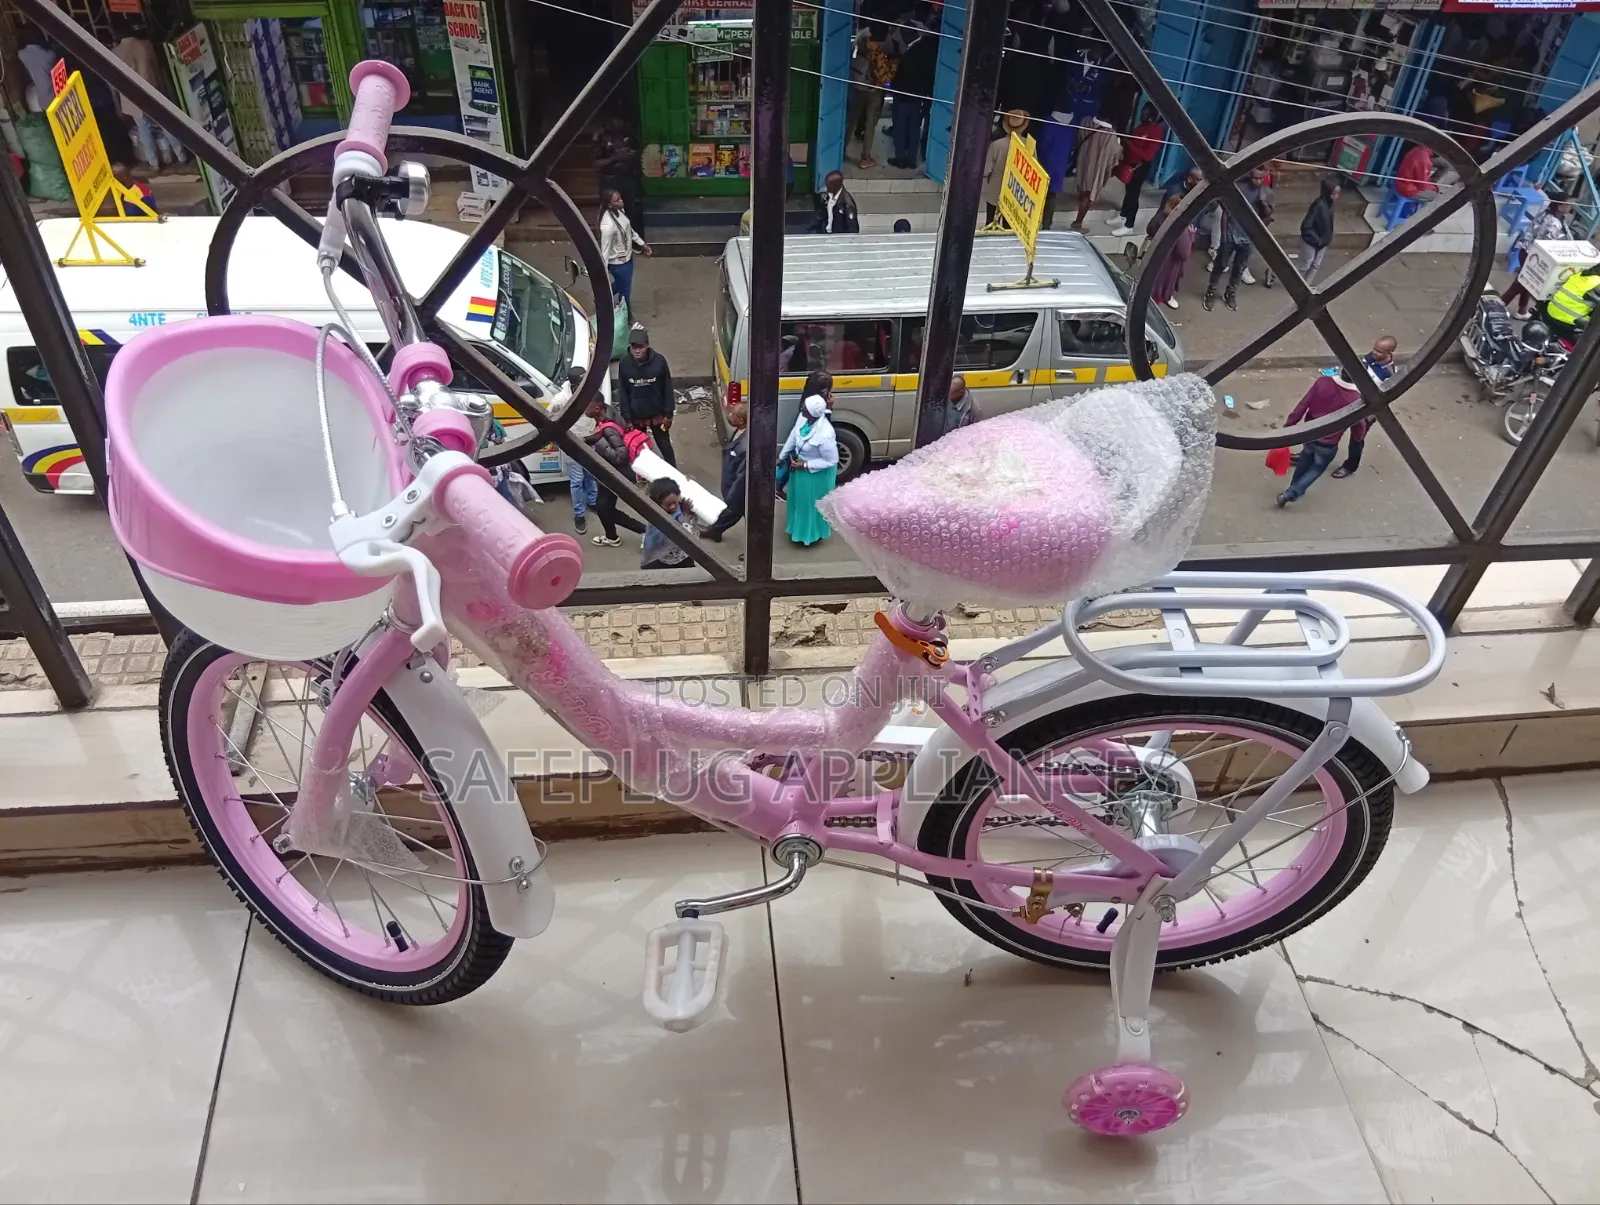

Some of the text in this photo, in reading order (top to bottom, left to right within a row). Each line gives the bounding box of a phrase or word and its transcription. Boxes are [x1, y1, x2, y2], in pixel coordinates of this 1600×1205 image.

[443, 1, 477, 19] BACK TO
[448, 21, 480, 39] SCHOOL
[473, 80, 490, 88] BANK
[474, 87, 493, 95] AGENT
[56, 87, 86, 146] NYERI
[72, 132, 97, 183] DIRECT
[1014, 148, 1041, 194] NYERI
[1008, 170, 1035, 219] DIRECT
